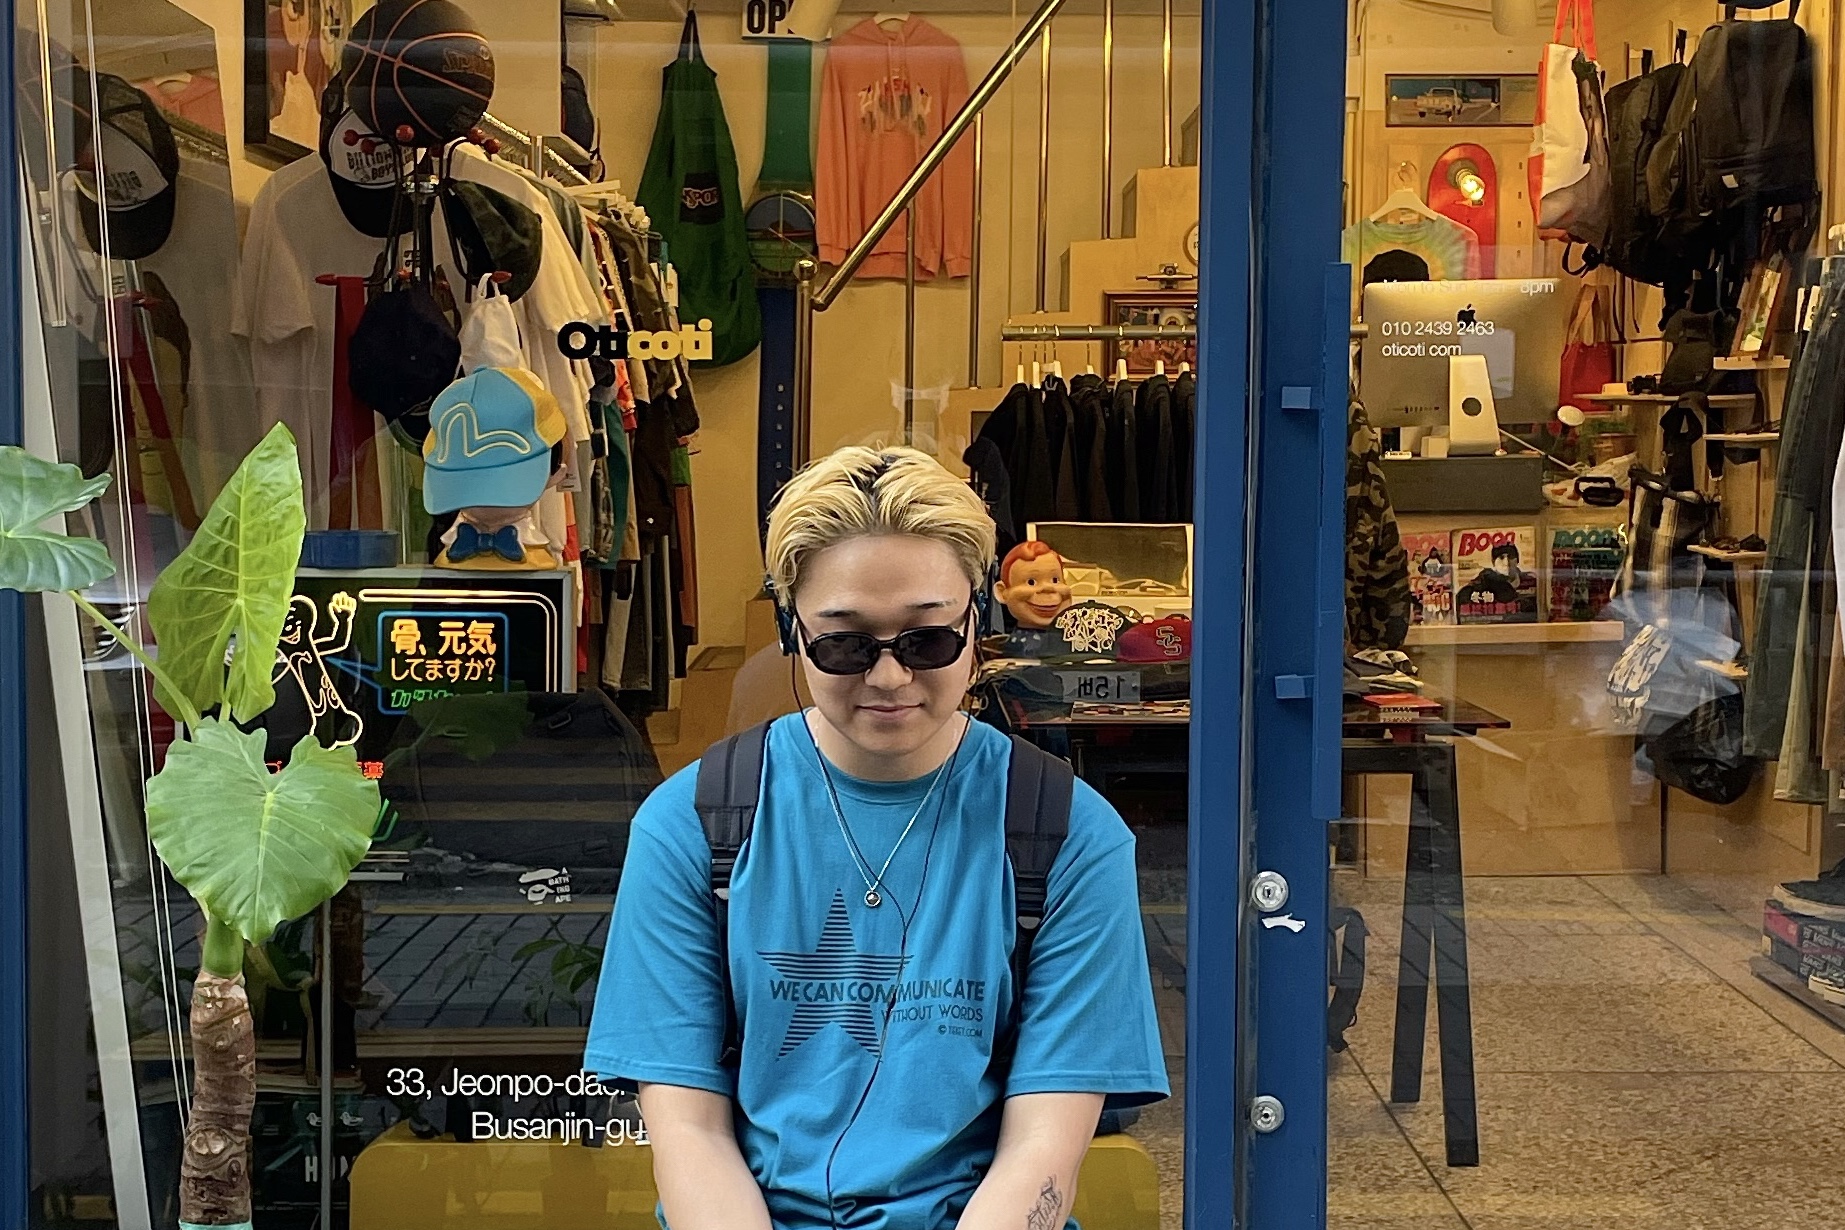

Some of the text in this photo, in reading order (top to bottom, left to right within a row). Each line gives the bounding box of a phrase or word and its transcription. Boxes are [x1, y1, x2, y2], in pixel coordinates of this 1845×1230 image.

[747, 0, 795, 34] OP
[557, 318, 713, 360] Oticoti
[1381, 322, 1495, 337] 010 2439 2463
[391, 657, 497, 683] してますか?
[938, 1003, 984, 1023] WORDS
[386, 1067, 626, 1103] 33, Jeonpo-da
[472, 1111, 644, 1147] Busanjin-gu
